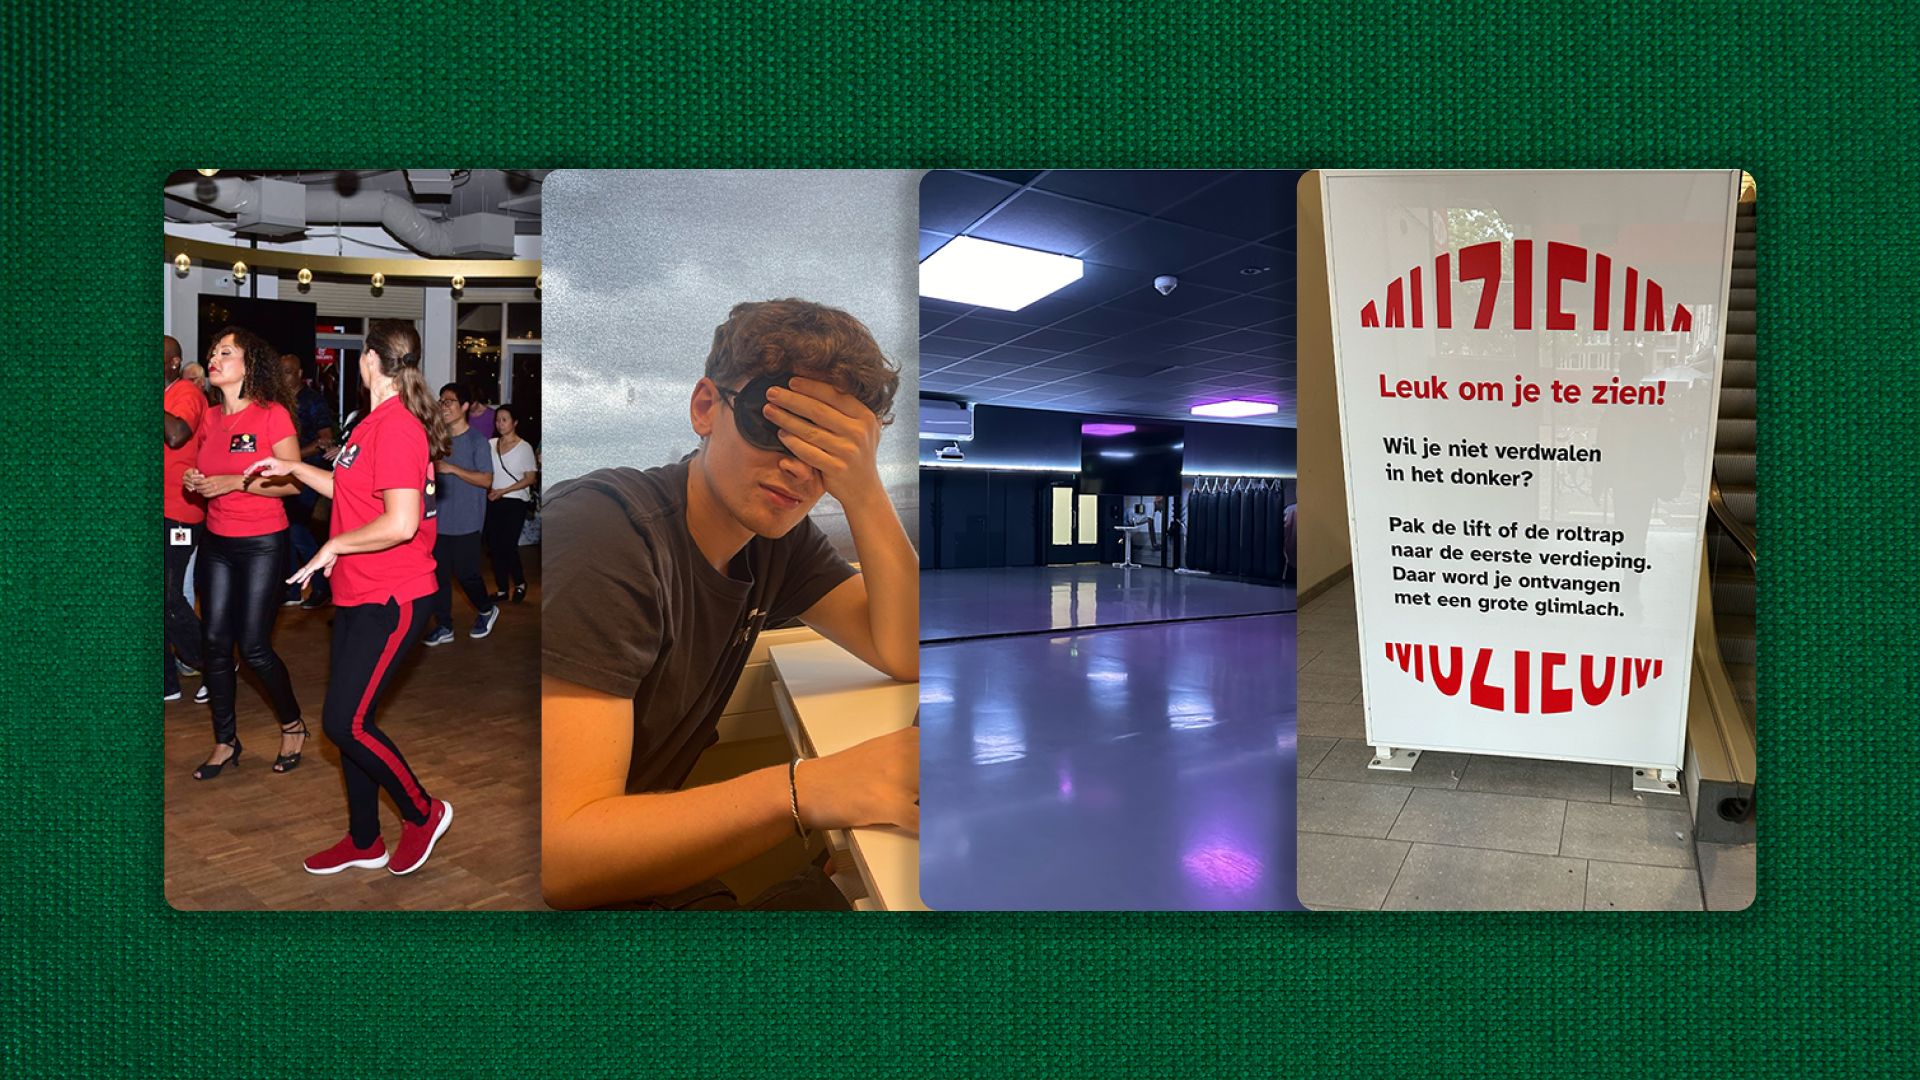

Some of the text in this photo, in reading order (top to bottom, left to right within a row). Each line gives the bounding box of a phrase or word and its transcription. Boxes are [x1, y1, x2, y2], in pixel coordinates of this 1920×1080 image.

[1379, 373, 1667, 407] Leuk om je te zien!
[1382, 436, 1602, 462] Wil je niet verdwalen
[1385, 462, 1533, 487] in het donker?
[1389, 516, 1625, 546] Pak de lift of de roltrap
[1391, 544, 1652, 574] naar de eerste verdieping.
[1392, 566, 1620, 596] Daar word je ontvangen
[1394, 592, 1625, 617] met een grote glimlach.
